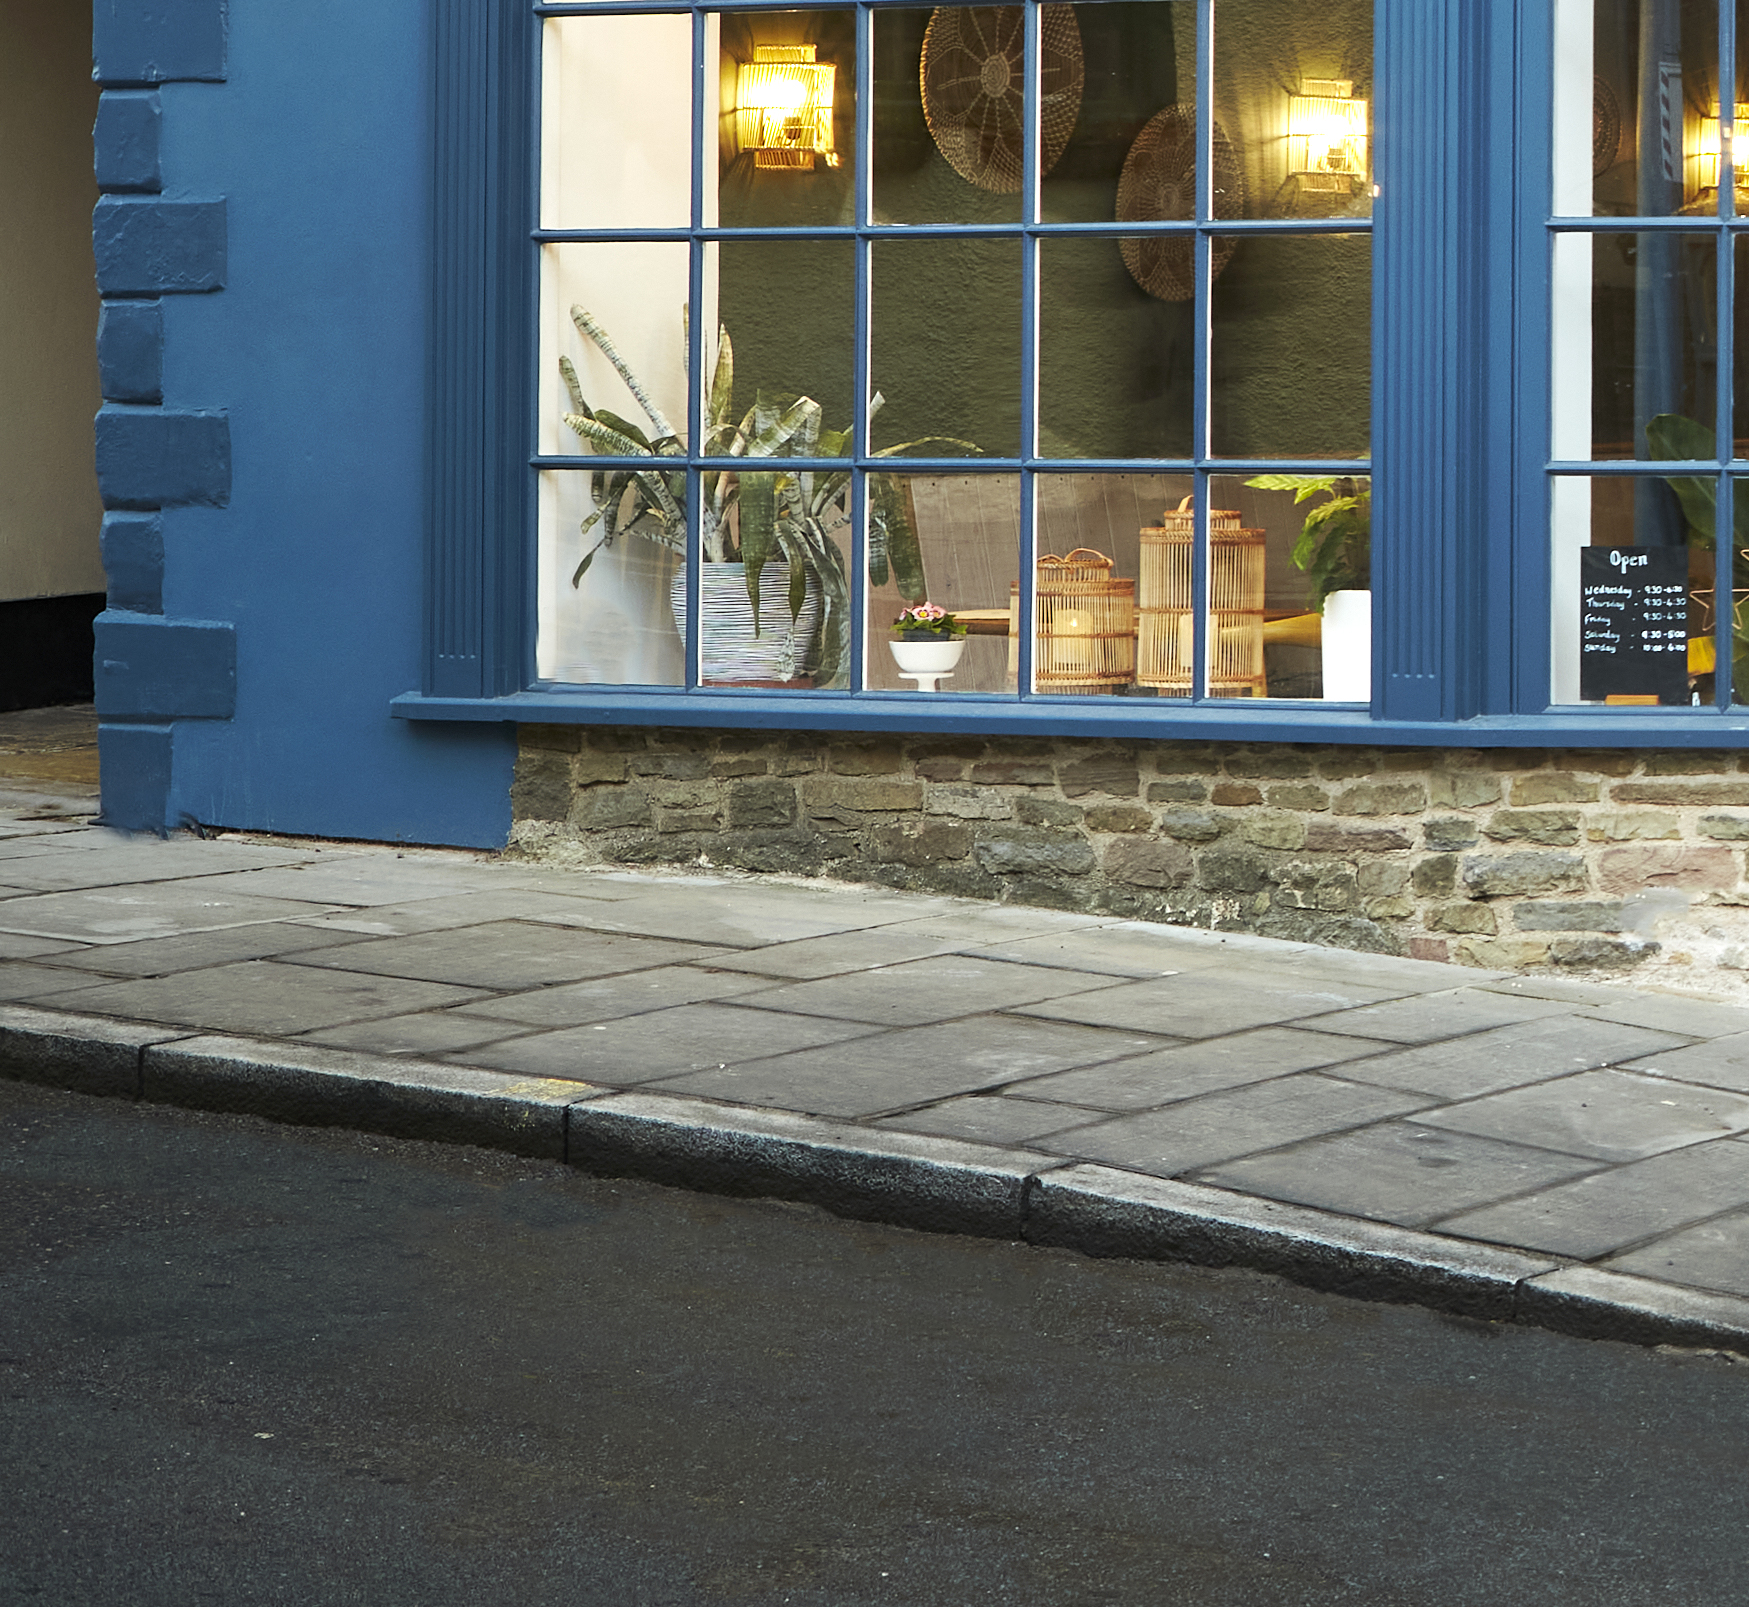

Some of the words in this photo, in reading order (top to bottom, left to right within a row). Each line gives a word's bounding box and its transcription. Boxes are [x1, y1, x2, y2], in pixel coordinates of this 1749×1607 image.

[1609, 550, 1648, 574] Open
[1586, 596, 1625, 611] Thursday
[1584, 613, 1611, 626] Friday
[1584, 629, 1621, 643] Saturday
[1584, 643, 1617, 654] Sunday
